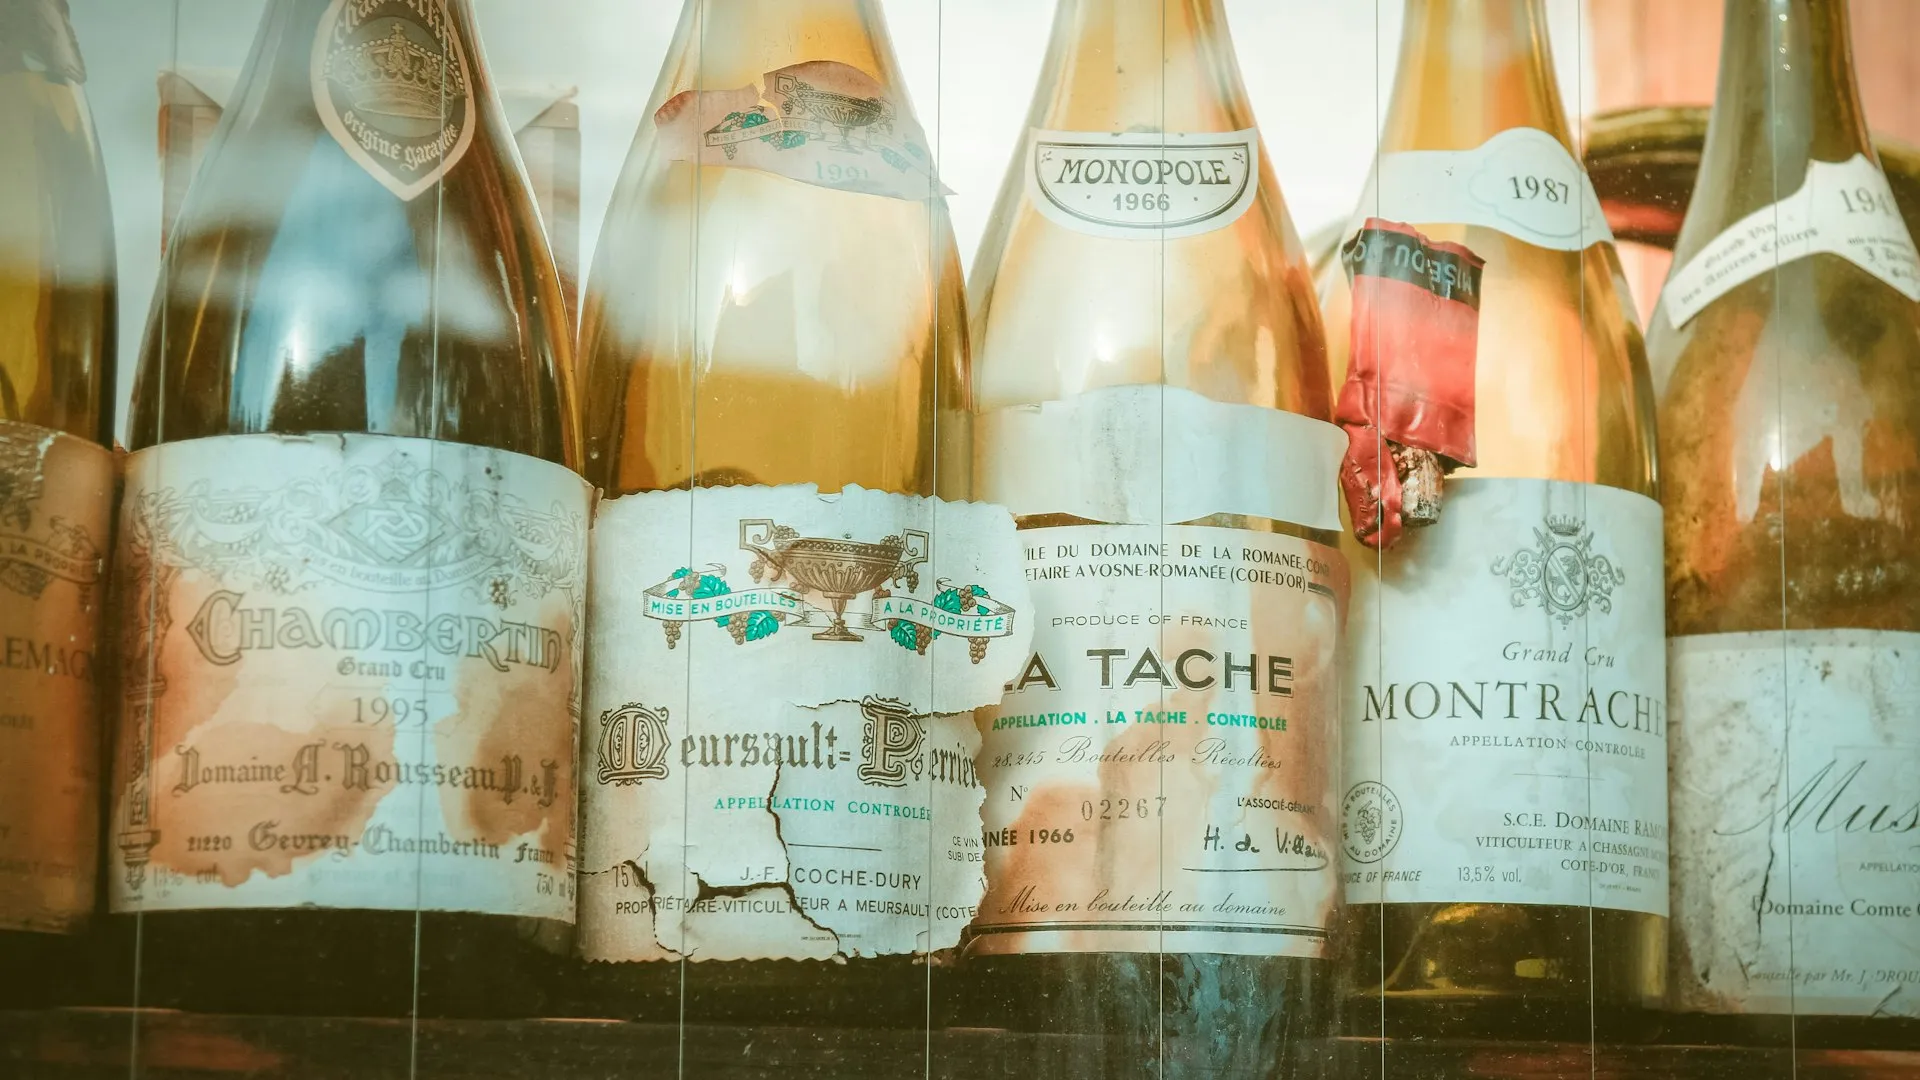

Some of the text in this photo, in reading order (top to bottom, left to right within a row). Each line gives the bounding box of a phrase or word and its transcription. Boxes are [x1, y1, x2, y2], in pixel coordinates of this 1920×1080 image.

[1054, 158, 1232, 186] MONOPOLE
[1506, 173, 1571, 206] 1987
[1112, 192, 1171, 212] 1966
[1394, 243, 1426, 274] DU
[1430, 259, 1474, 297] MISE
[1024, 546, 1047, 561] ILE
[1057, 544, 1080, 559] DU
[1091, 543, 1169, 557] DOMAINE
[1181, 544, 1202, 559] DE
[1213, 546, 1232, 560] LA
[1075, 564, 1086, 578] A
[1088, 563, 1227, 580] VOSNE-ROMANÉE
[1230, 565, 1306, 593] (COTE-D'OR)
[651, 592, 796, 616] MISE EN BOUTEILLES
[883, 601, 1004, 632] A LA PROPRIÉTÉ
[1052, 614, 1248, 630] PRODUCE OF FRANCE
[1502, 641, 1616, 668] Grand Cru
[336, 656, 446, 681] Grand Cru
[1003, 646, 1294, 699] A TACHE
[351, 696, 429, 727] 1995
[992, 710, 1287, 732] APPELLATION LA TACHE CONTROLÉE
[992, 735, 1282, 769] 28.245 Bouteilles Récoltées
[1450, 735, 1568, 750] APPELLATION
[171, 744, 286, 798] Domaine
[332, 742, 501, 793] Rousseau
[714, 797, 836, 813] APPELLATION
[1081, 795, 1168, 821] 02267
[1503, 812, 1547, 828] S.C.E.
[248, 820, 500, 863] Gevrey-Chambertin
[952, 835, 979, 848] CE VIN
[1029, 828, 1075, 845] 1966
[1364, 819, 1398, 858] DOMAINE
[1475, 836, 1572, 851] VITICULTEUR
[1579, 841, 1588, 852] A
[947, 850, 965, 862] SUBI
[739, 866, 922, 891] J.-F. COCHE-DURY
[1366, 871, 1379, 883] OF
[1382, 870, 1422, 882] FRANCE
[1457, 865, 1522, 884] 13,5% vol.
[837, 901, 848, 912] A
[856, 900, 931, 918] MEURSAULT
[936, 905, 977, 921] (COTE
[1000, 885, 1288, 916] Mise en bouteille au domaine
[1752, 895, 1845, 916] Domaine
[1851, 898, 1913, 918] Comte
[1803, 971, 1827, 986] par
